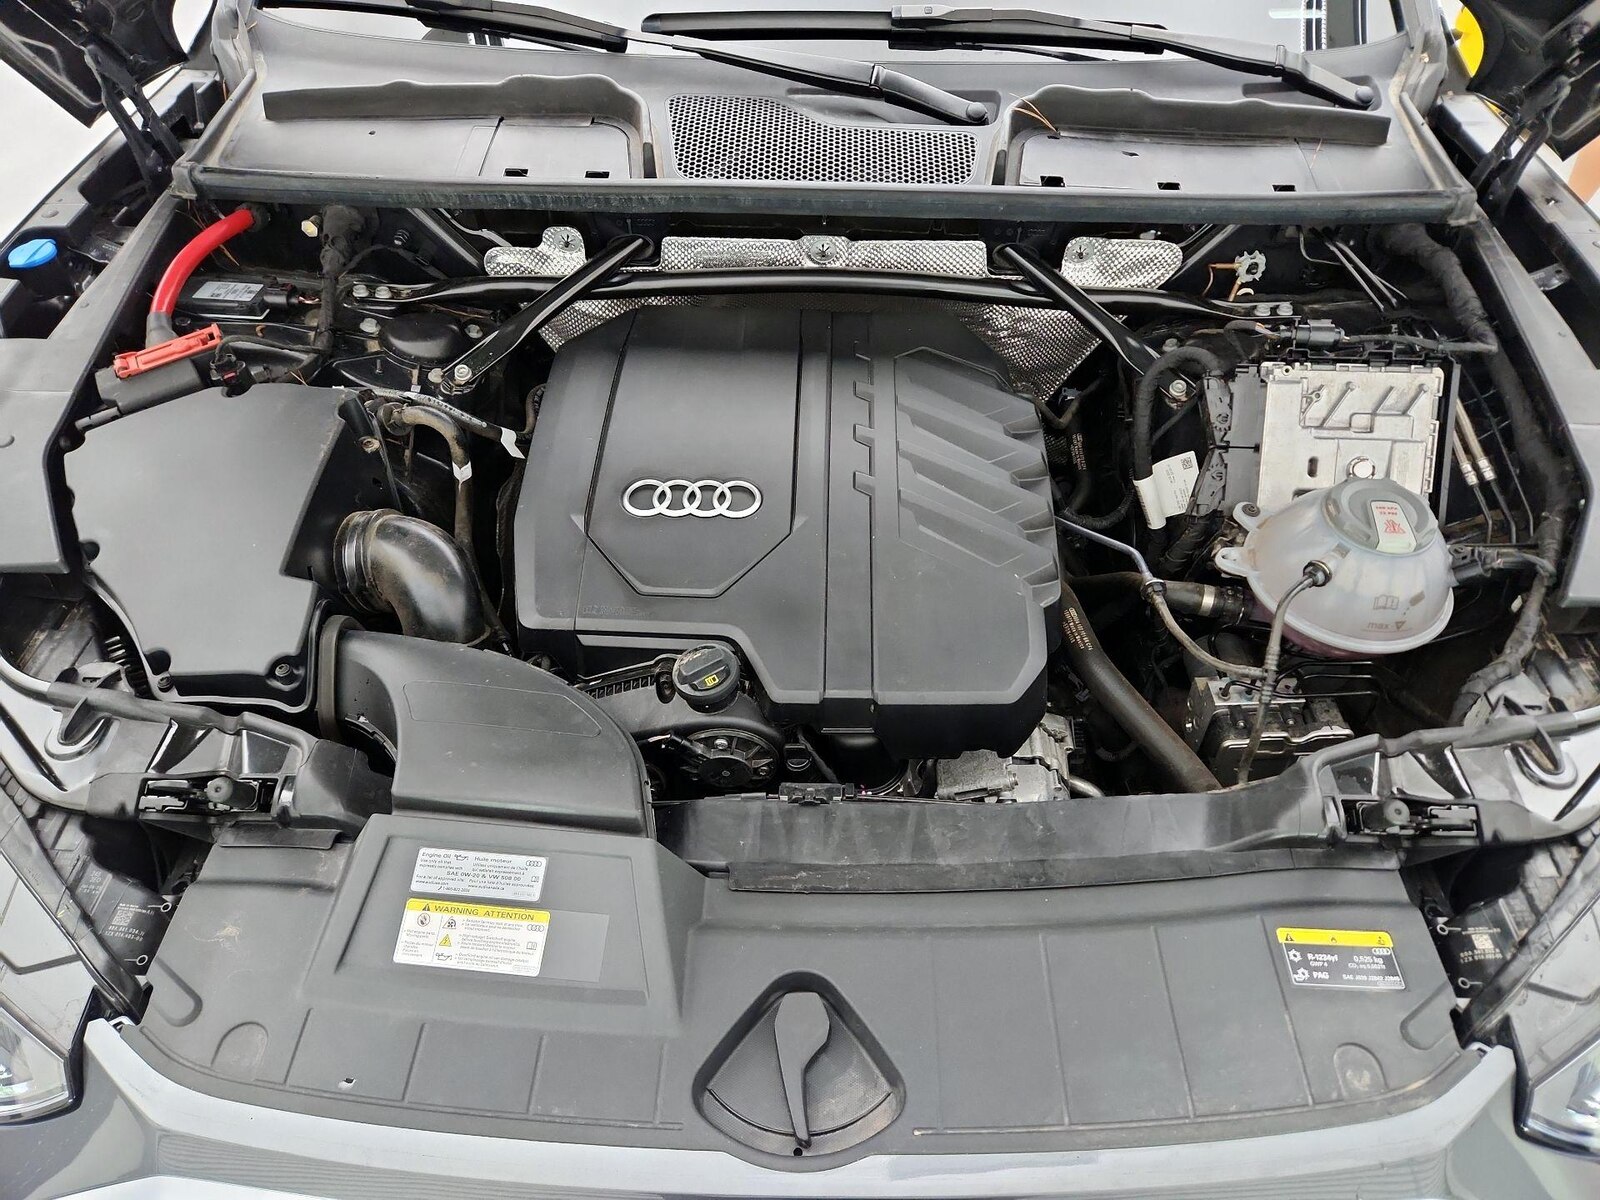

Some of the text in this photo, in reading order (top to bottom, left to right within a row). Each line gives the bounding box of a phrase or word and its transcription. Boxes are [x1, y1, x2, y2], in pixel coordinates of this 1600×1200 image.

[434, 905, 535, 920] WARNING ATTENTION
[1374, 956, 1383, 964] kg
[1313, 971, 1329, 980] PAG
